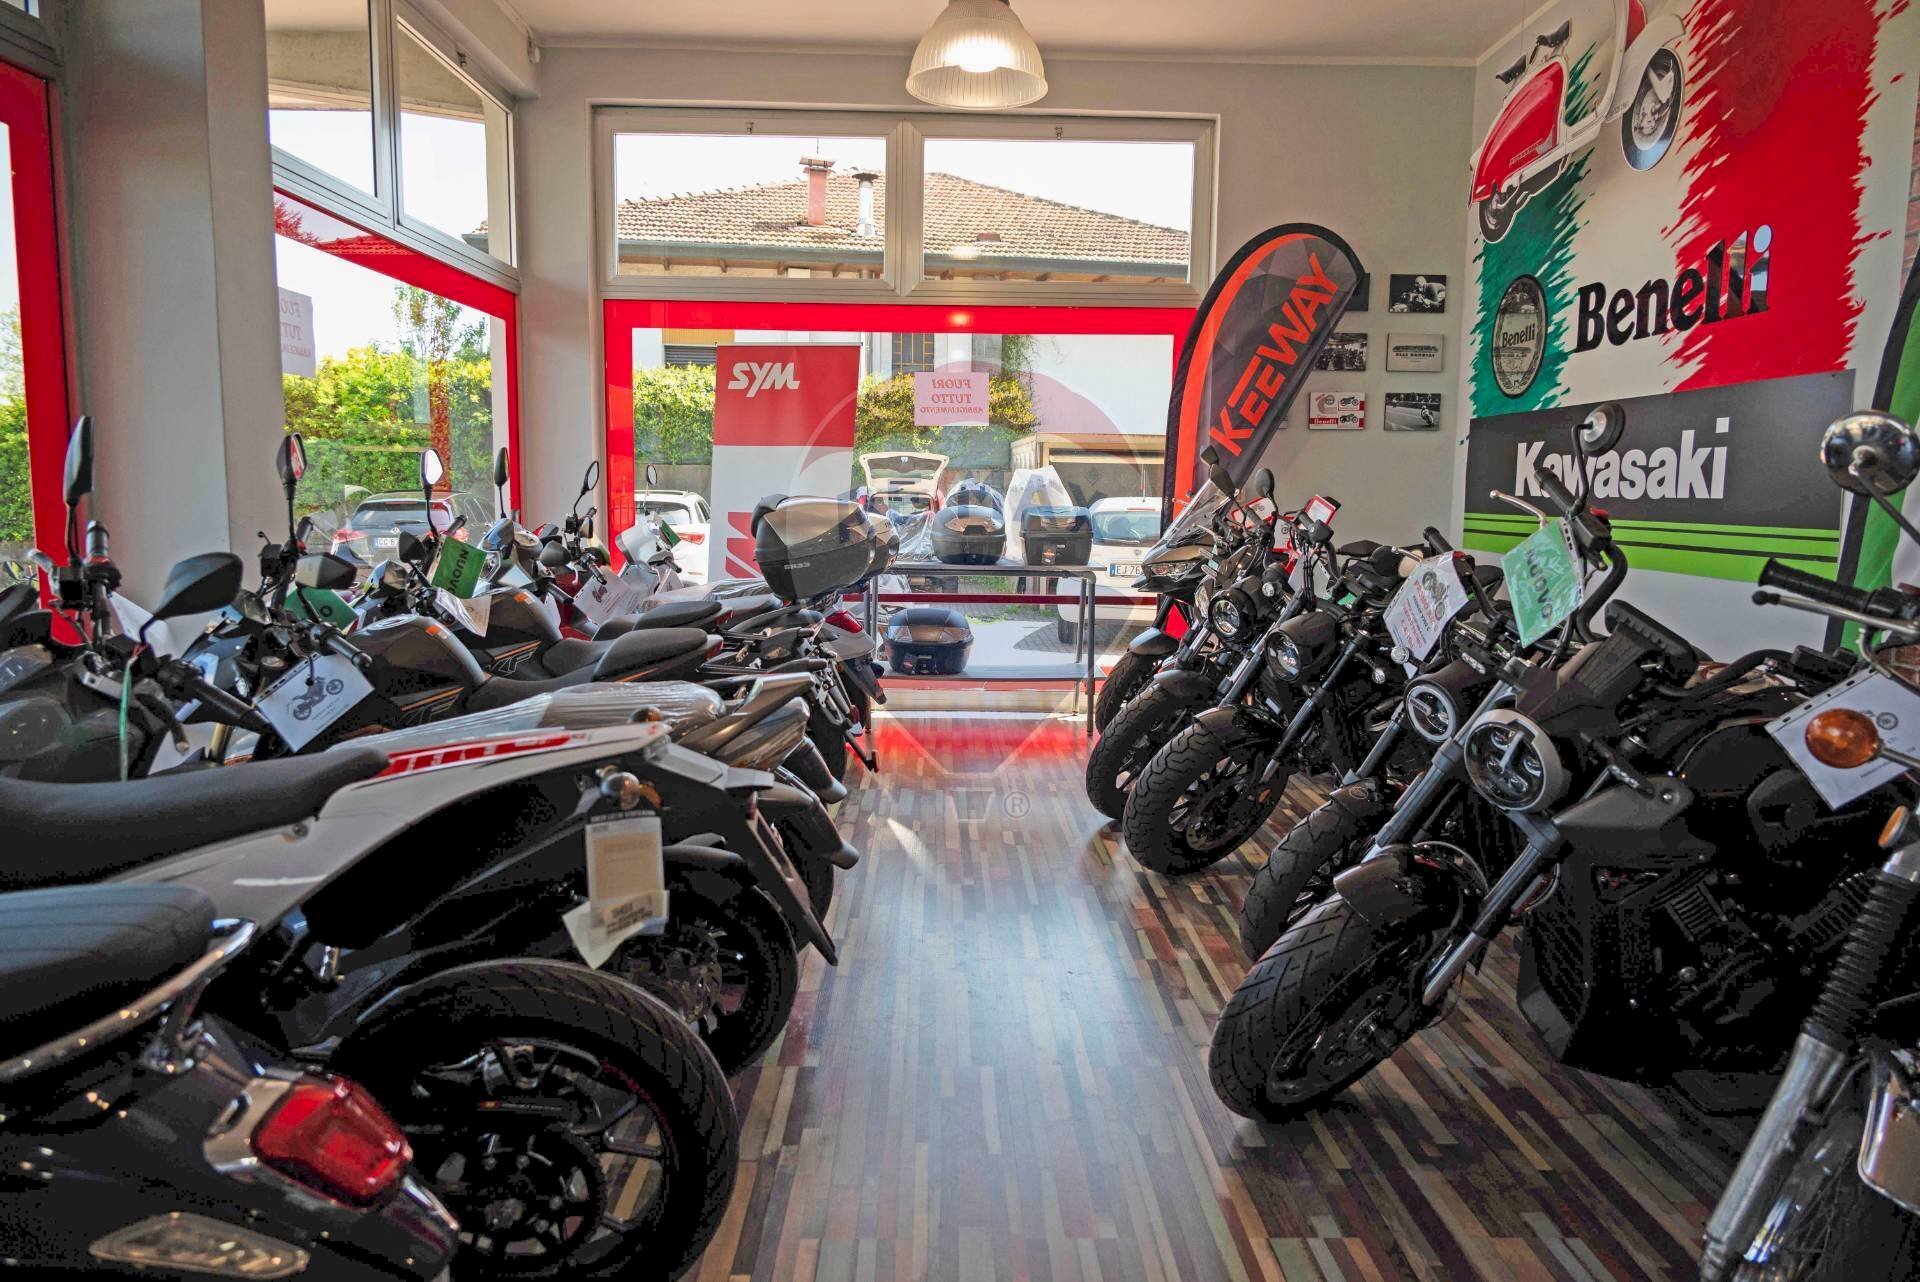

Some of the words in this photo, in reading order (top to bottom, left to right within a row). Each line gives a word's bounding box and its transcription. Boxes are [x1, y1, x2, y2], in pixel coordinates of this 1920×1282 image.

[1573, 224, 1773, 354] Benelli
[1209, 252, 1339, 457] KEEWAY
[1502, 323, 1536, 348] Benelli
[727, 361, 801, 398] SYM
[1514, 416, 1730, 500] Kawasaki
